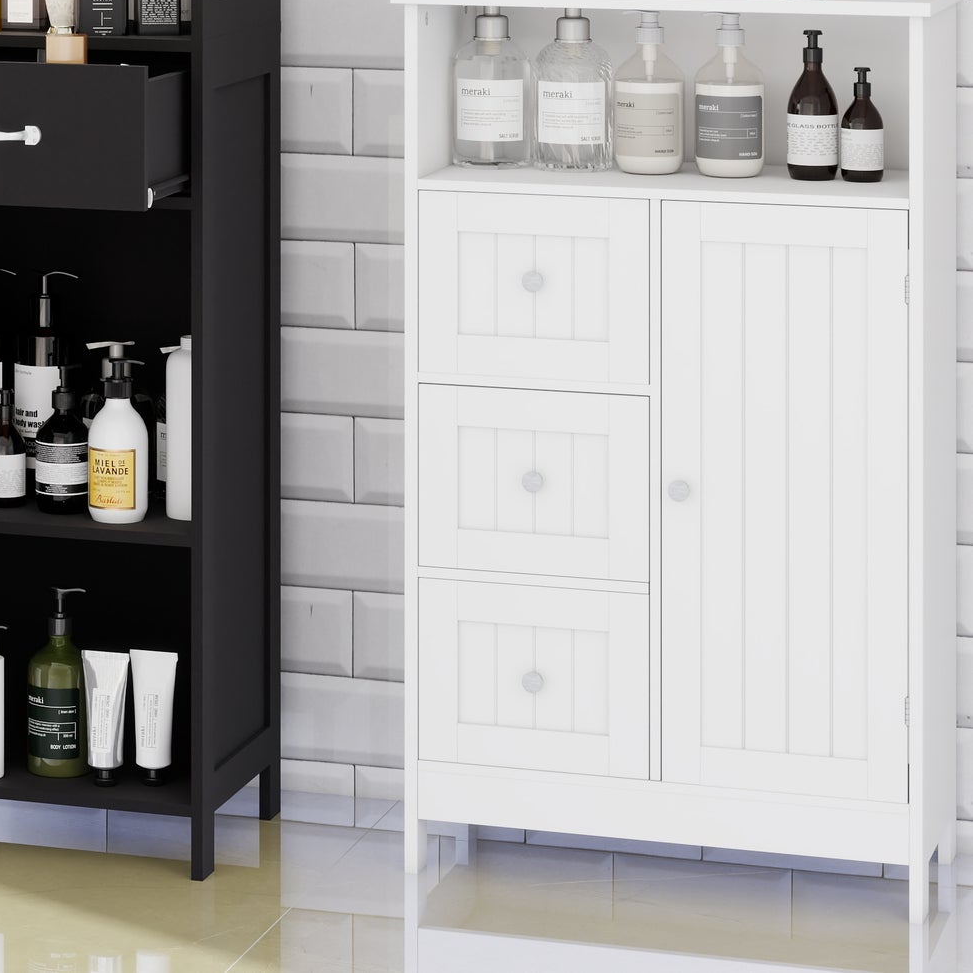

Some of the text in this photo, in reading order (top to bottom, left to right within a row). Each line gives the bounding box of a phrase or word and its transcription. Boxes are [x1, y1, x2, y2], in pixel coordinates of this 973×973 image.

[461, 87, 491, 96] meraki
[542, 90, 573, 99] meraki
[25, 410, 38, 418] and
[94, 458, 116, 468] MIEL
[92, 465, 129, 475] LAVANDE
